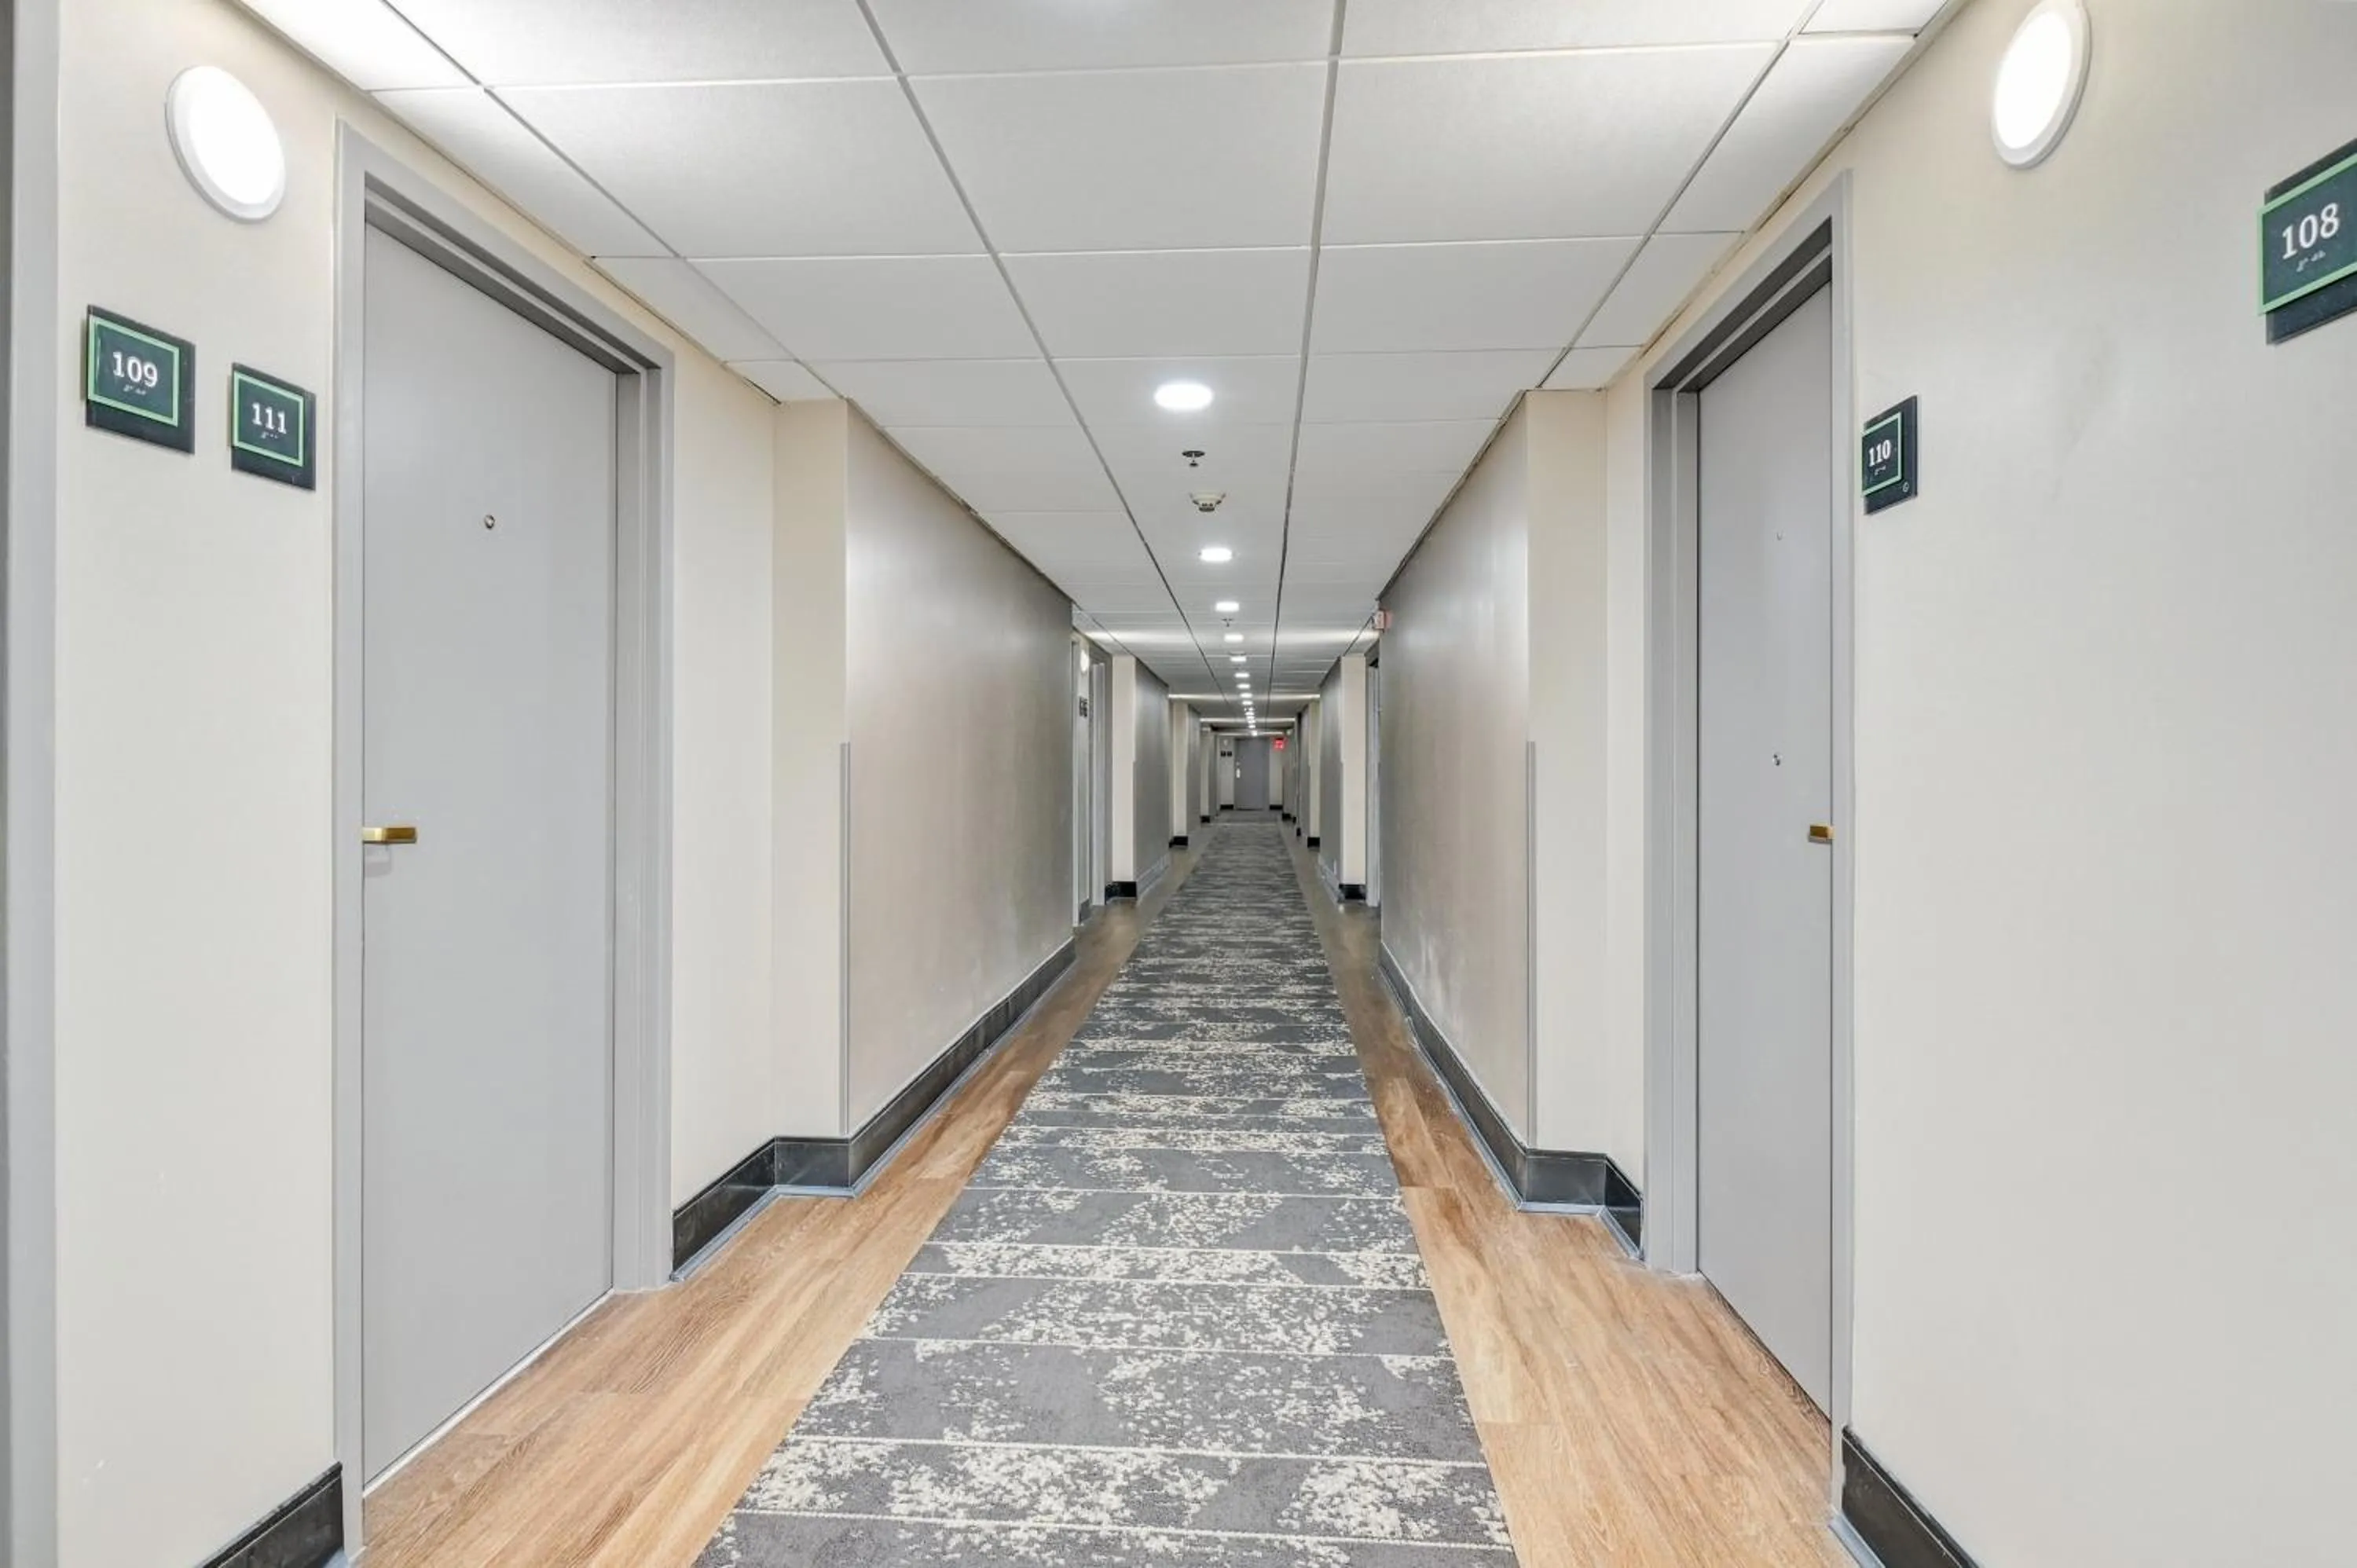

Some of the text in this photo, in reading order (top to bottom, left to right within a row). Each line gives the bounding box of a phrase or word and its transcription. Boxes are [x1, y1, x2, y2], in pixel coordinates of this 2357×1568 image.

[2282, 202, 2340, 259] 108
[112, 351, 158, 388] 109
[251, 403, 287, 434] 111
[1868, 439, 1892, 467] 110
